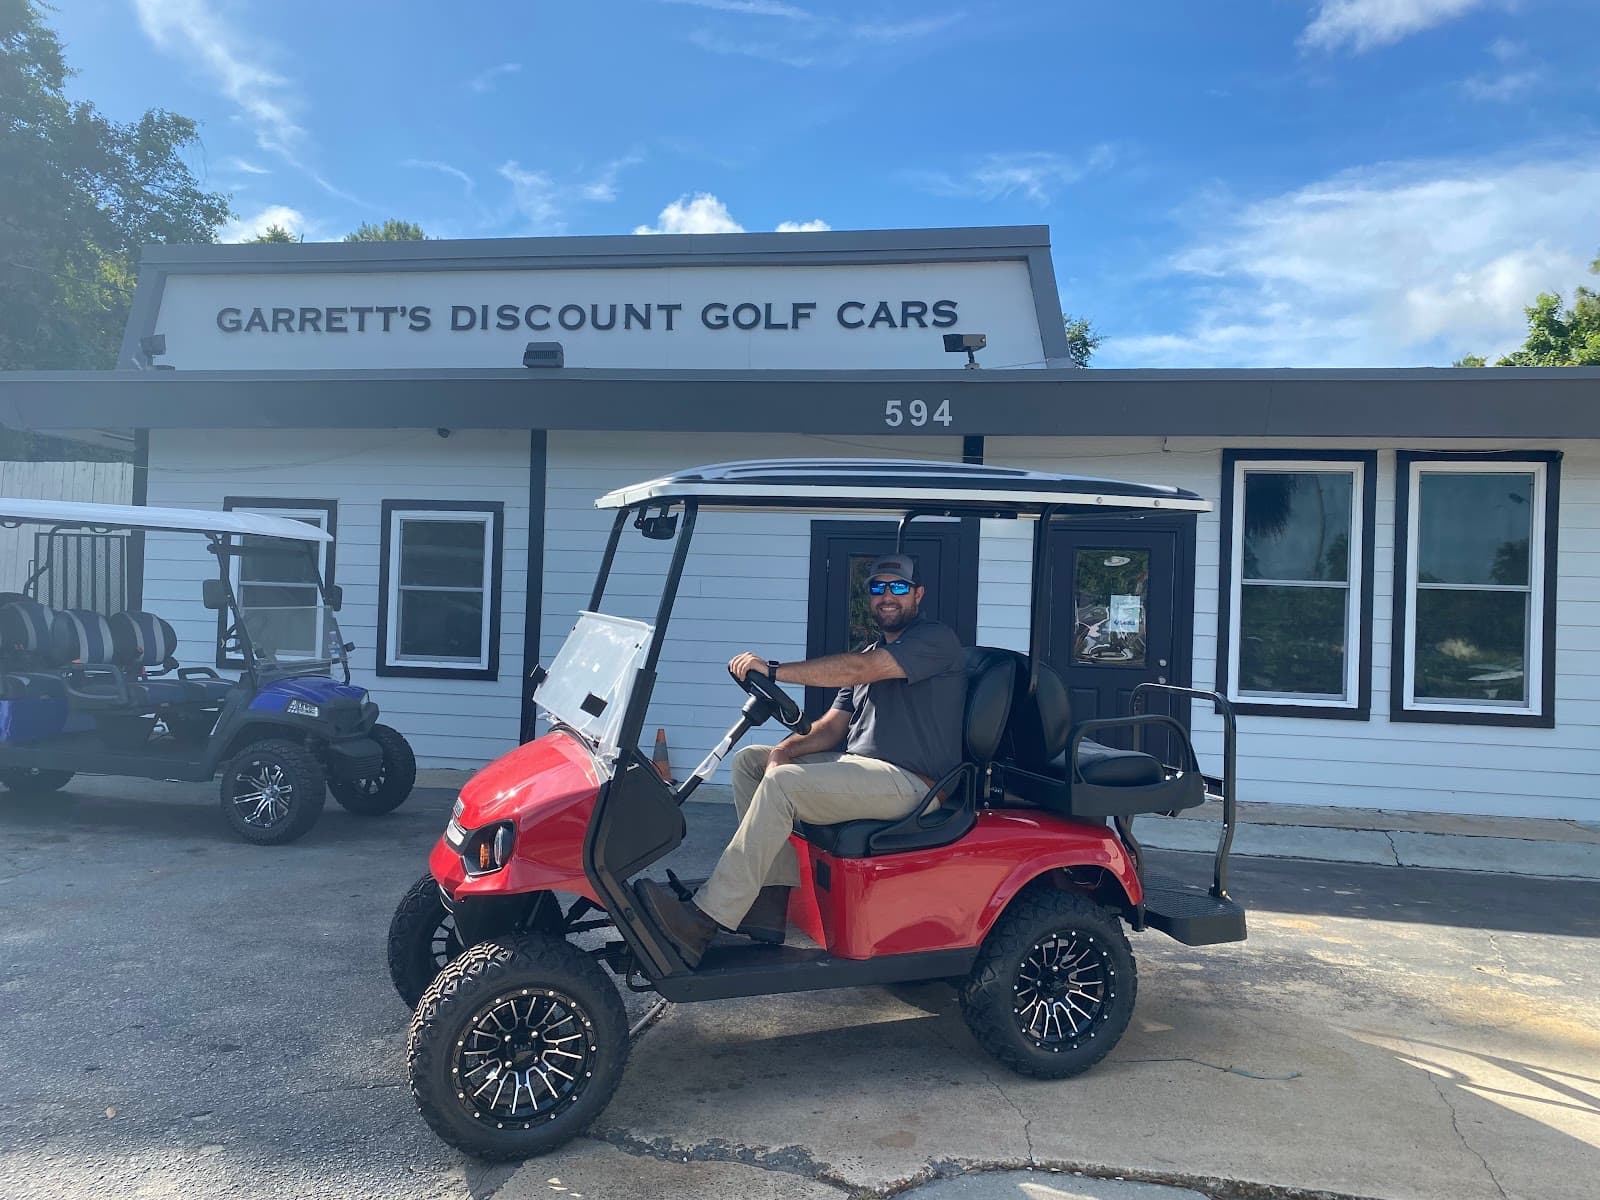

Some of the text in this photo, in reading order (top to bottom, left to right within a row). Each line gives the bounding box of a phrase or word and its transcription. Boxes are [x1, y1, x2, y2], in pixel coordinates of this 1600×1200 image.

[217, 300, 959, 333] GARRETT'S DISCOUNT GOLF CARS
[885, 399, 953, 427] 594
